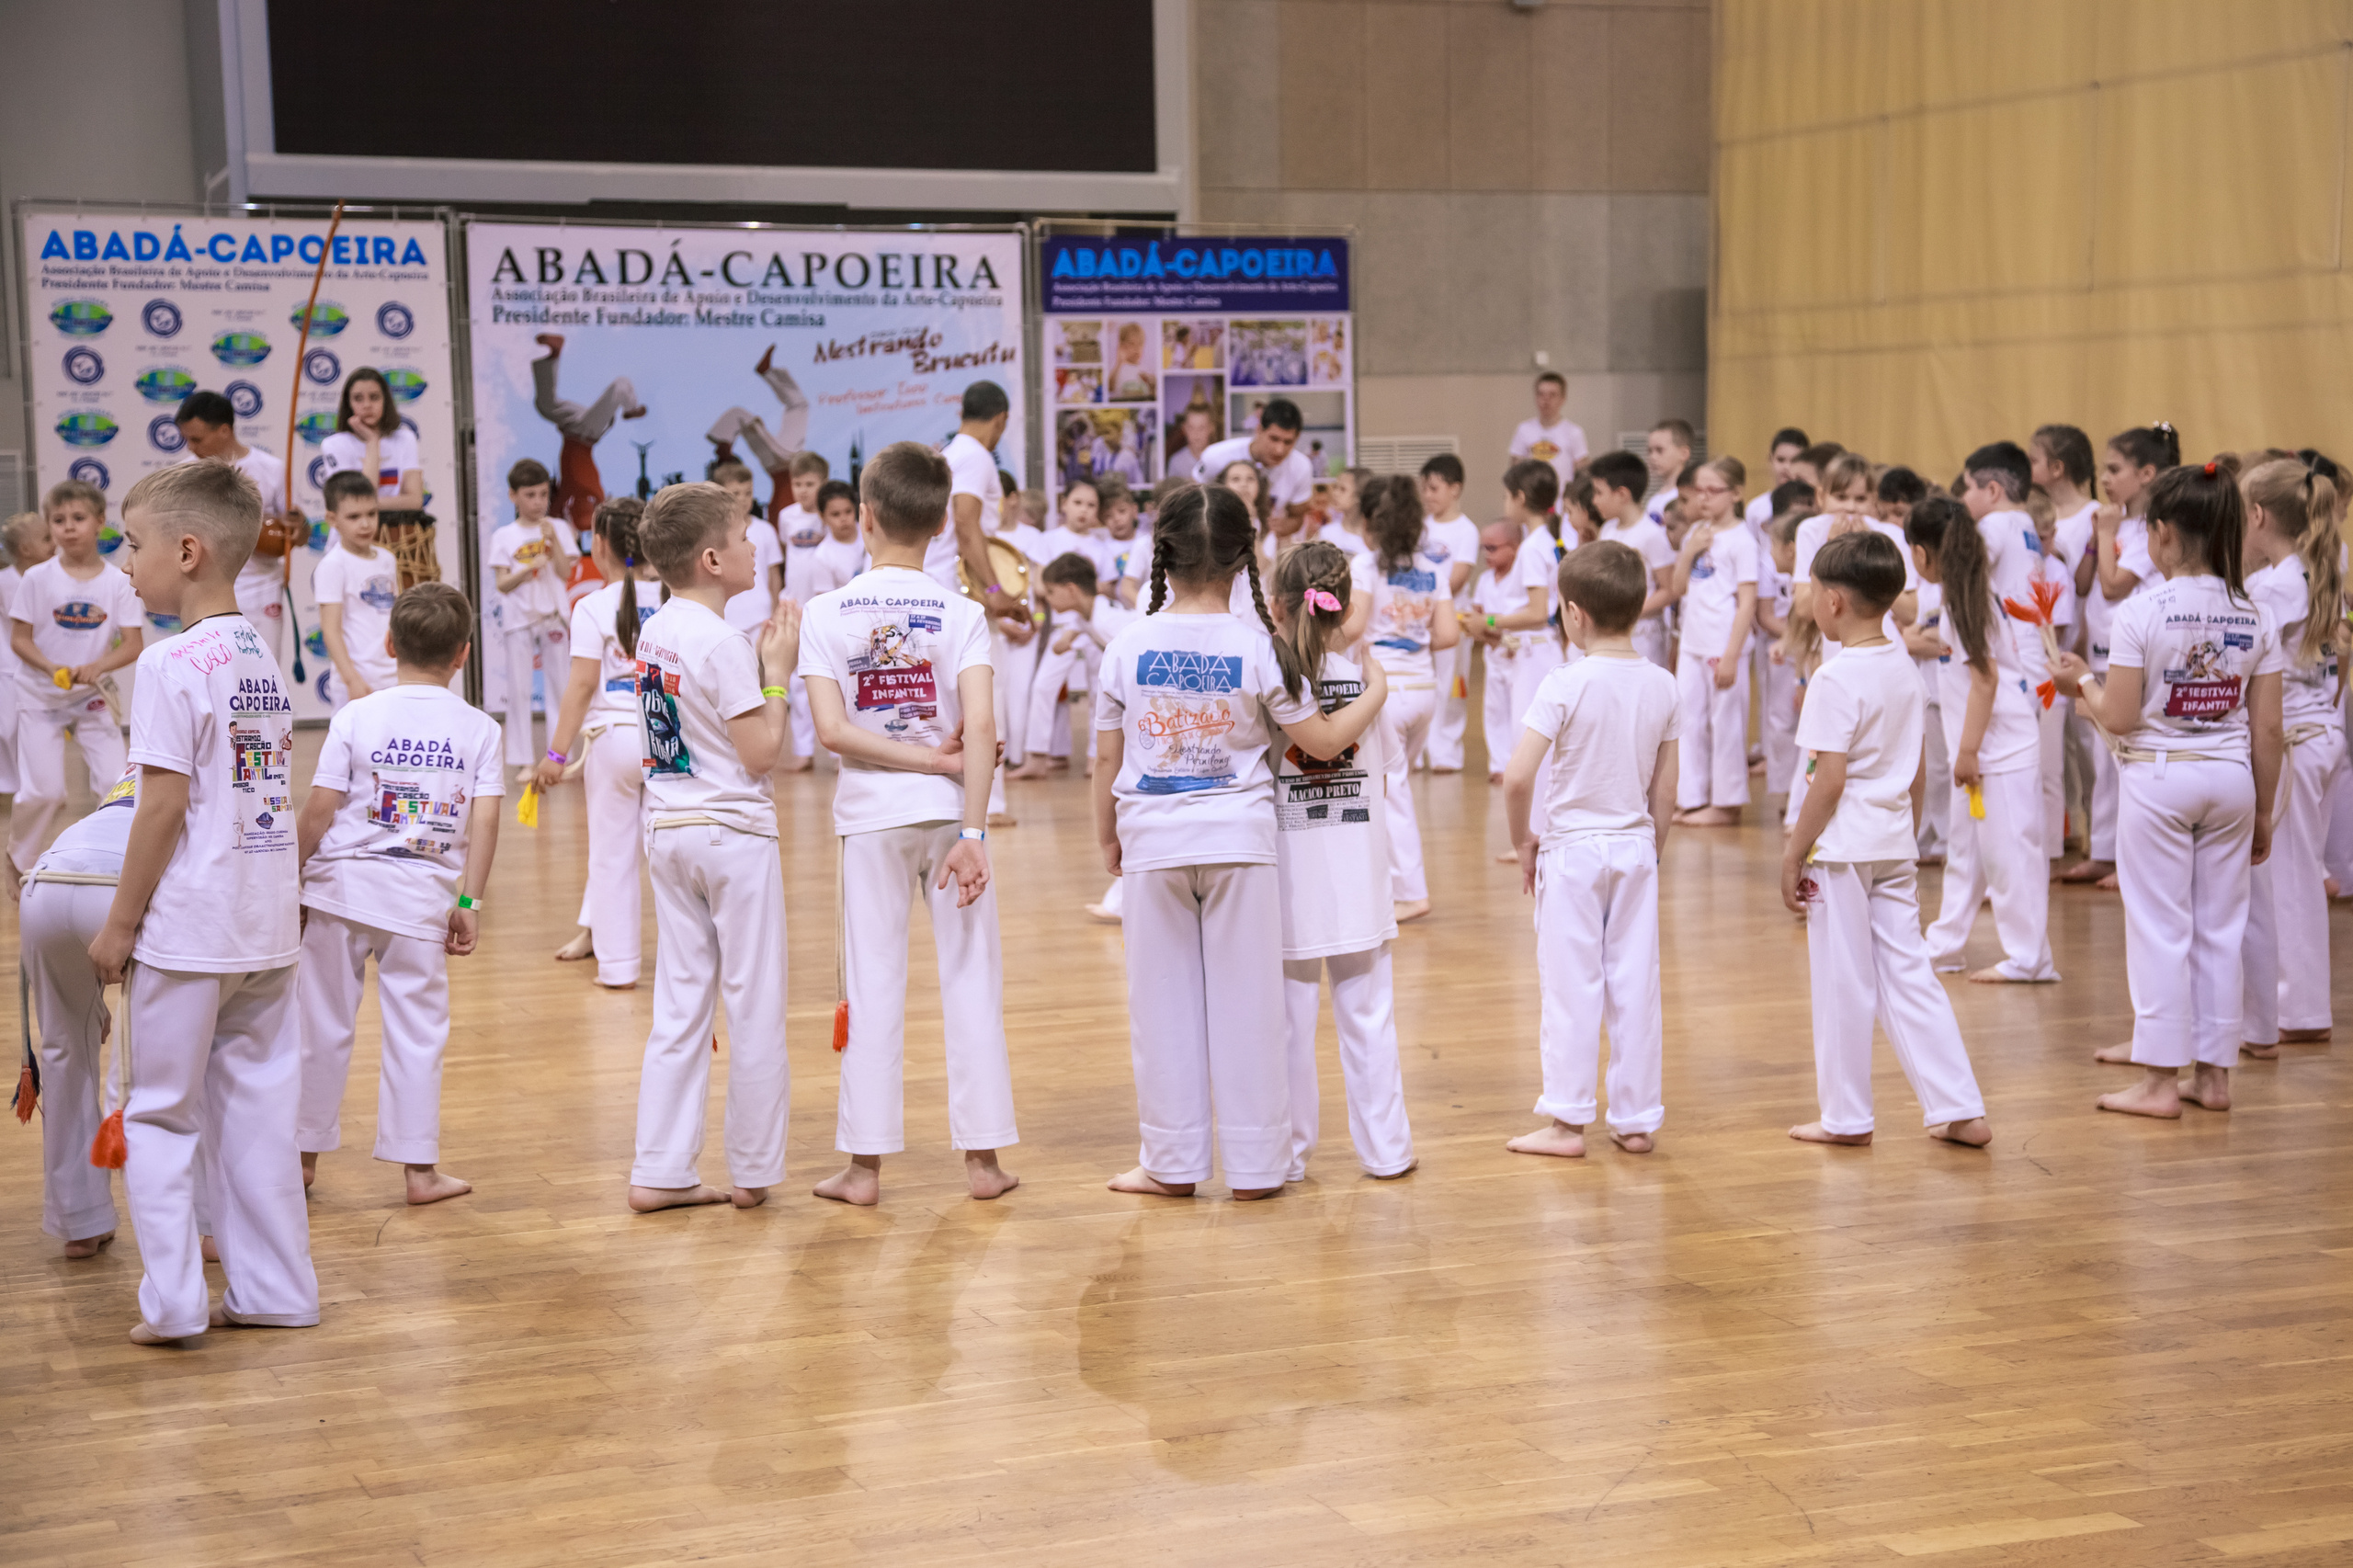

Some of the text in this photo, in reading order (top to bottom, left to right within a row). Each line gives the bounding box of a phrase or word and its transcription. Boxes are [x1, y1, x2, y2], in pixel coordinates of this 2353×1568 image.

[40, 223, 427, 266] ABADÁ-CAPOEIRA
[491, 238, 1003, 290] ABADÁ-CAPOEIRA
[1051, 240, 1340, 278] ABADÁ-CAPOEIRA
[492, 287, 577, 305] Associação
[581, 288, 658, 304] Brasileira
[661, 290, 680, 304] de
[685, 290, 732, 309] Apoio
[734, 294, 742, 305] e
[746, 290, 878, 307] Desenvolvimento
[881, 291, 898, 306] da
[492, 305, 591, 324] Presidente
[694, 307, 756, 326] Mestre
[760, 308, 826, 326] Camisa
[1149, 651, 1232, 676] ABADÁ
[239, 675, 278, 694] ABADÁ
[1146, 672, 1233, 691] CAPOEIRA
[1318, 683, 1367, 697] APOEIRA
[229, 695, 291, 711] CAPOEIRA
[872, 687, 926, 700] INFANTIL
[387, 737, 452, 755] ABADÁ
[370, 750, 465, 771] CAPOEIRA
[1289, 783, 1360, 802] MACACO PRETO
